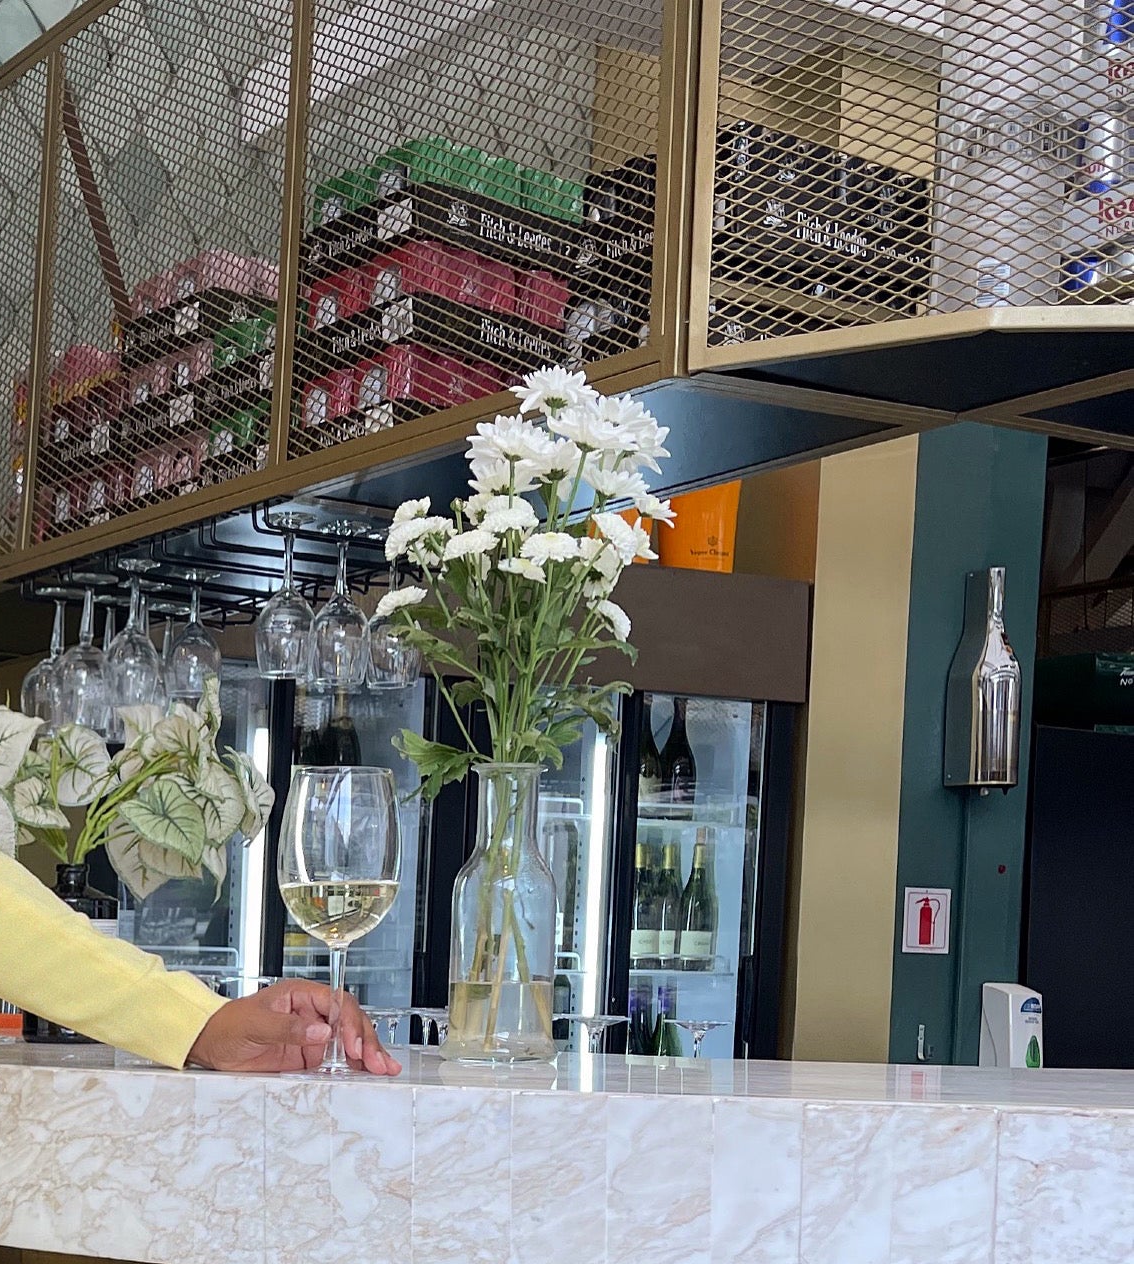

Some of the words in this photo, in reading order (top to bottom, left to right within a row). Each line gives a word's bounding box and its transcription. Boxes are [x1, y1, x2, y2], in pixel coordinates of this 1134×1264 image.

[479, 212, 506, 242] Fitch
[517, 225, 552, 255] Leedes
[796, 211, 822, 244] Fitch
[479, 318, 506, 348] Fitch
